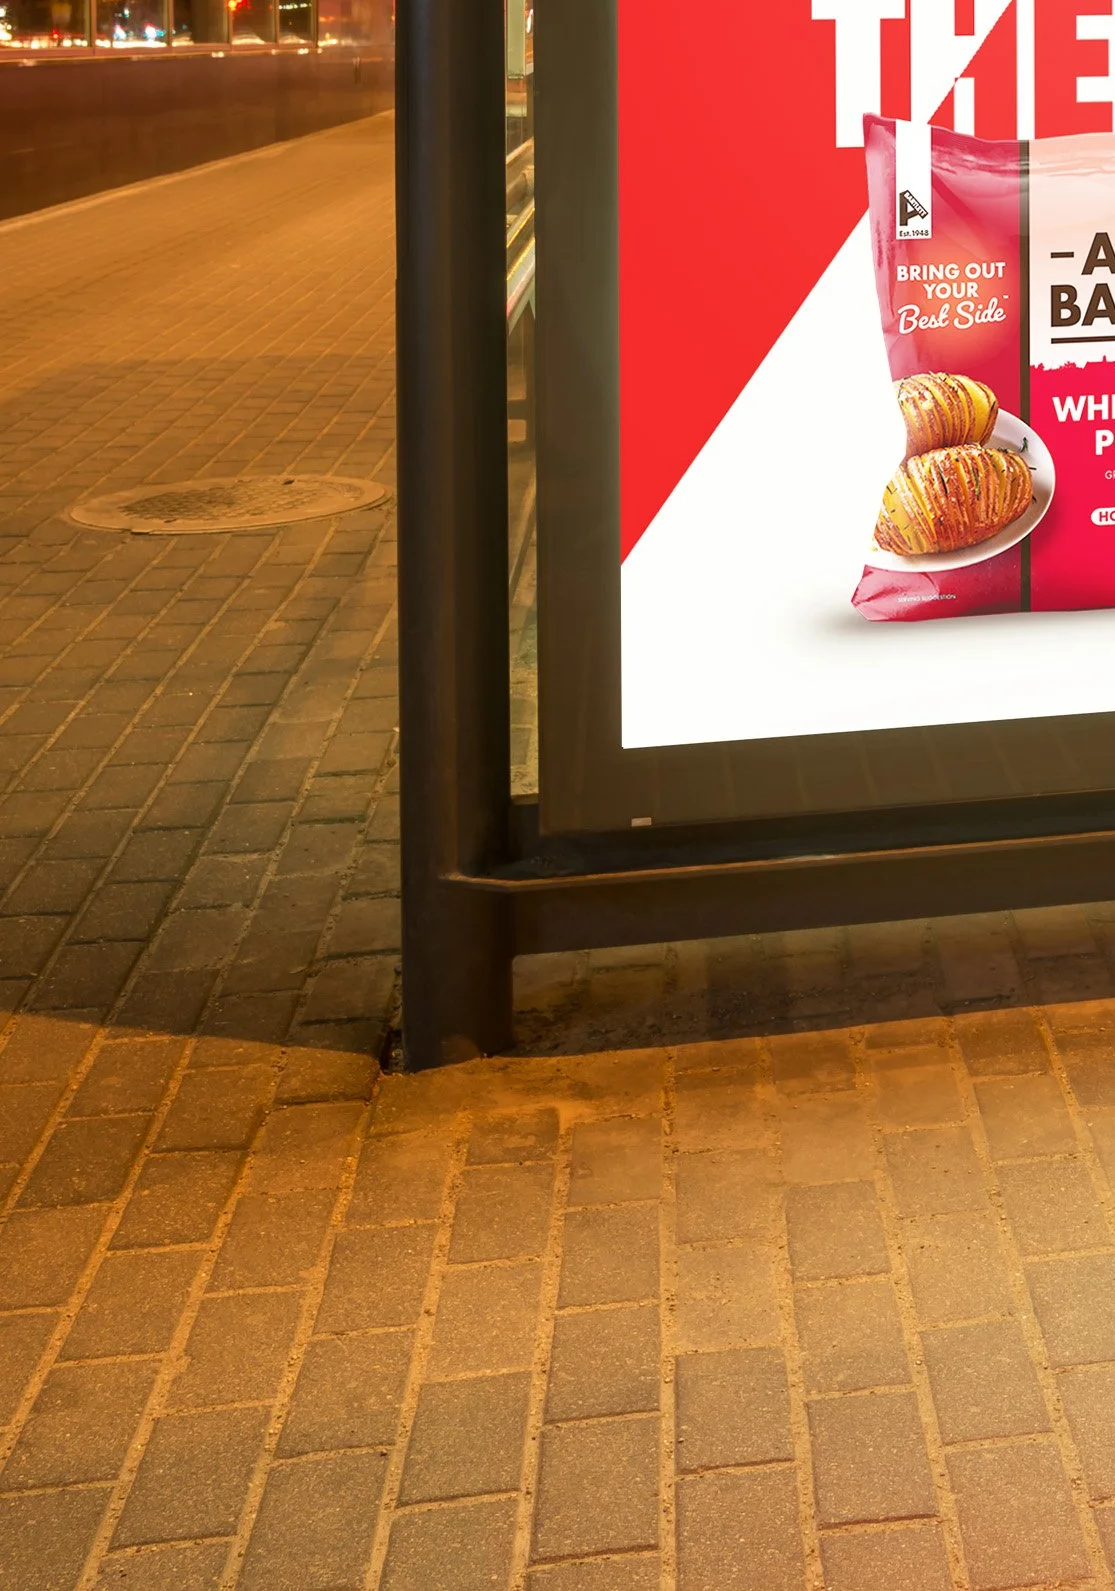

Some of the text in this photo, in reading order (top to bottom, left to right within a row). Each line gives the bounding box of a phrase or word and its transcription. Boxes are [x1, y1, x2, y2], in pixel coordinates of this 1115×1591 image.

[897, 262, 1006, 281] BRING OUT
[923, 282, 979, 299] YOUR
[897, 297, 1006, 334] Best Side
